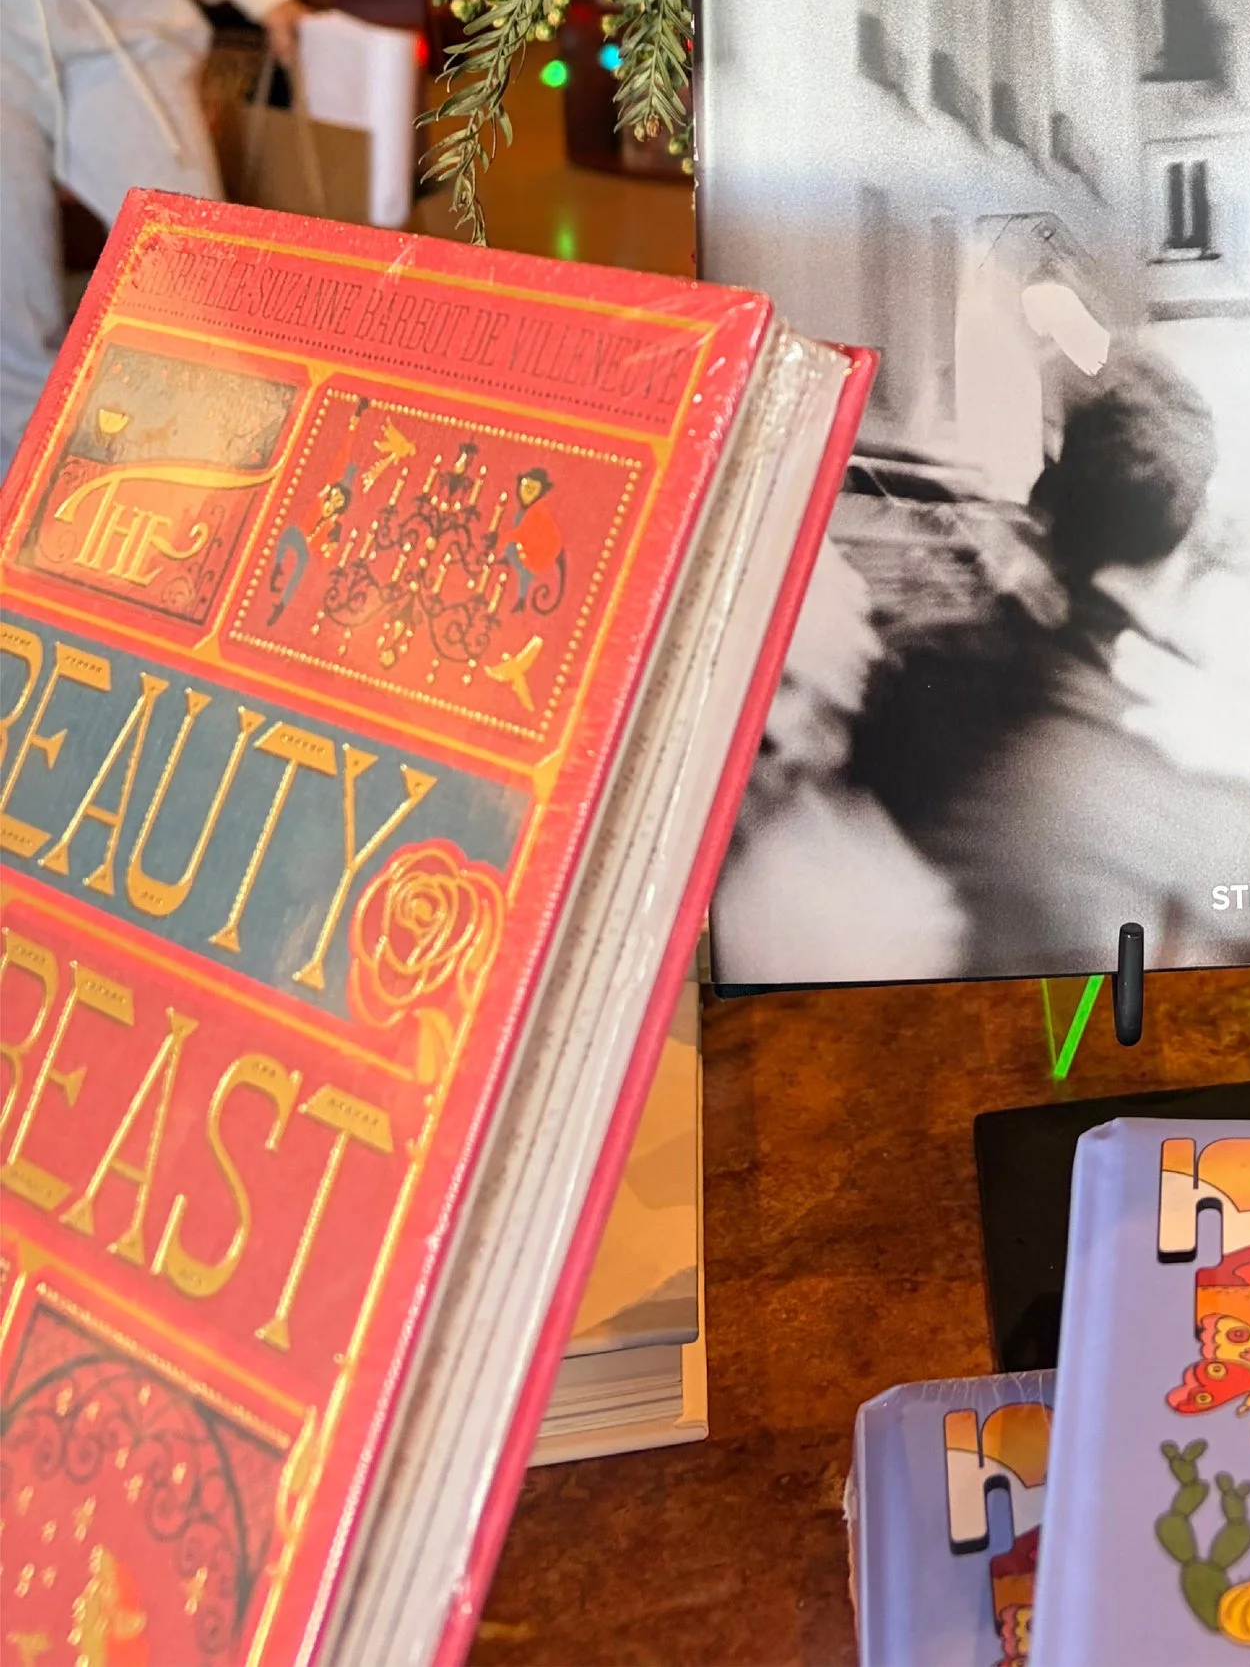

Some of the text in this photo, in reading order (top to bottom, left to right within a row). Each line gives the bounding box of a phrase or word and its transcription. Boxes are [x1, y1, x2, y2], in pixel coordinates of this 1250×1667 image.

[356, 285, 469, 358] BARBOT
[460, 308, 510, 367] DE
[54, 465, 283, 587] THE
